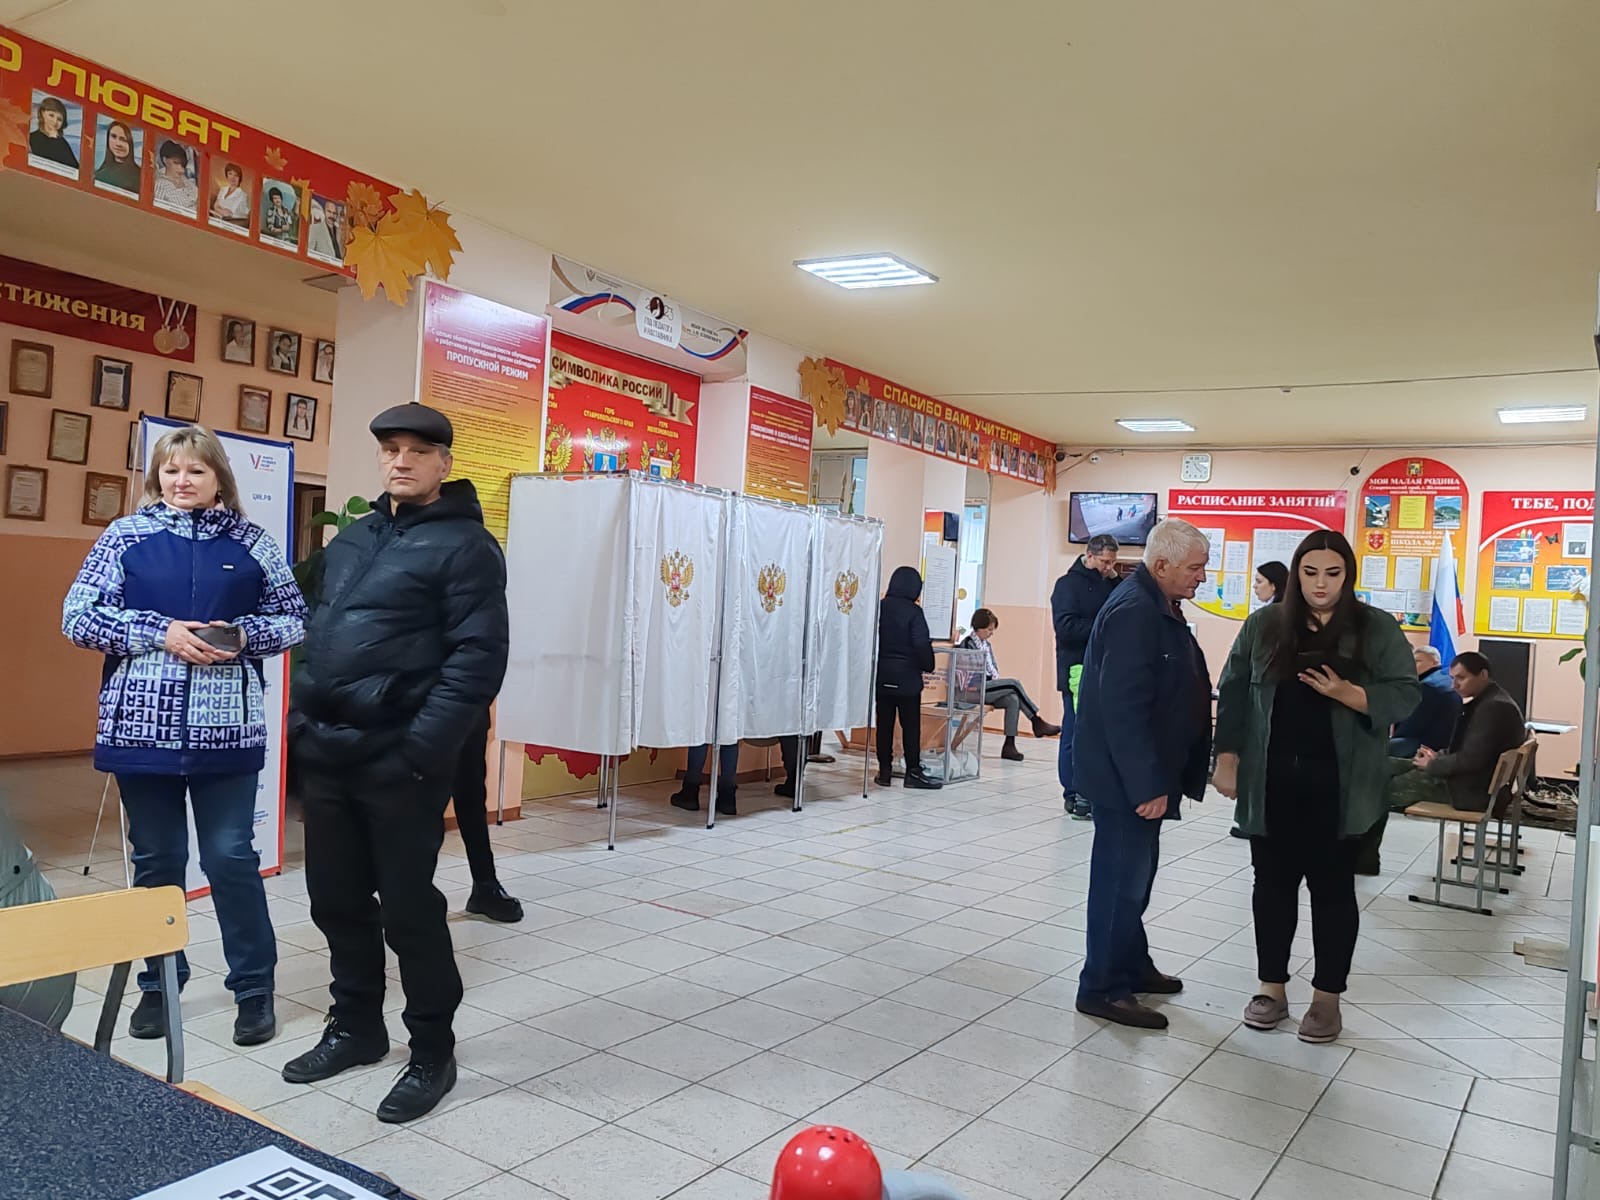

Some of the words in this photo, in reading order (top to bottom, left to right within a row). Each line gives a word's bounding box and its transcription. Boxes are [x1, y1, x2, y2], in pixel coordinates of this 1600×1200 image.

[47, 58, 240, 153] ЛЮБЯТ
[0, 281, 147, 332] тижения
[446, 350, 500, 374] ПРОПУСКНОЙ
[501, 365, 529, 381] РЕЖИМ
[551, 355, 620, 390] СИМВОЛИКА
[621, 379, 663, 399] РОССИИ
[883, 384, 942, 417] СПАСИБО
[944, 407, 972, 429] ВАМ,
[974, 418, 1021, 445] УЧИТЕЛЯ!
[1177, 495, 1266, 507] РАСПИСАНИЕ
[1269, 494, 1336, 507] ЗАНЯТИЙ
[1511, 498, 1559, 511] ТЕБЕ,
